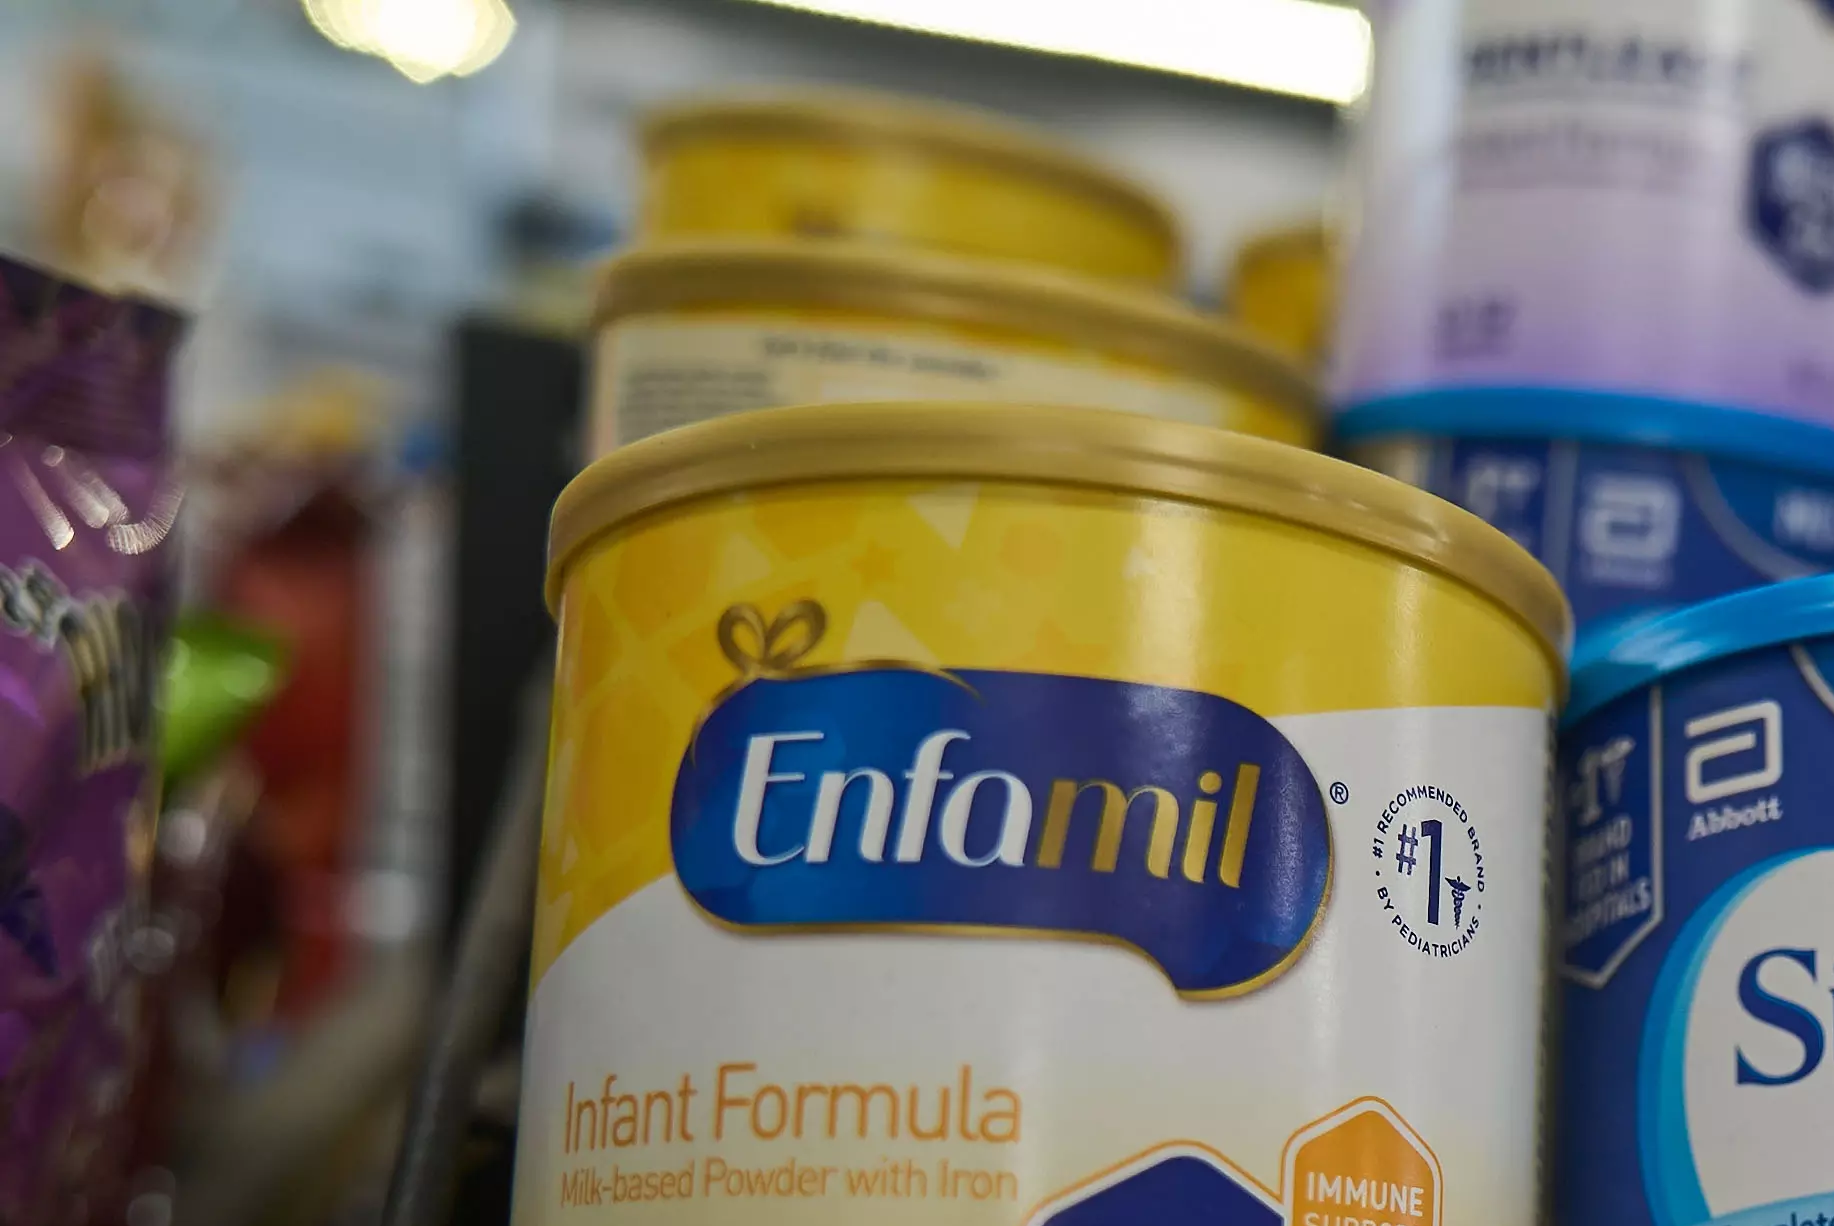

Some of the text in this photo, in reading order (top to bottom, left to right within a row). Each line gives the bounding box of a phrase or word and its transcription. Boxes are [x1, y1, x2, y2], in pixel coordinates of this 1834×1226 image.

[733, 727, 1262, 891] Enfamil
[1376, 785, 1468, 835] RECOMMENDED
[1467, 826, 1485, 893] BRAND
[1687, 796, 1784, 841] Abbott
[1396, 819, 1443, 926] #1
[1376, 886, 1480, 958] BY PEDIATRICIANS
[564, 1062, 1023, 1155] Infant Formula
[561, 1156, 1019, 1207] Milk-based Powder with Iron
[1305, 1171, 1425, 1218] IMMUNE
